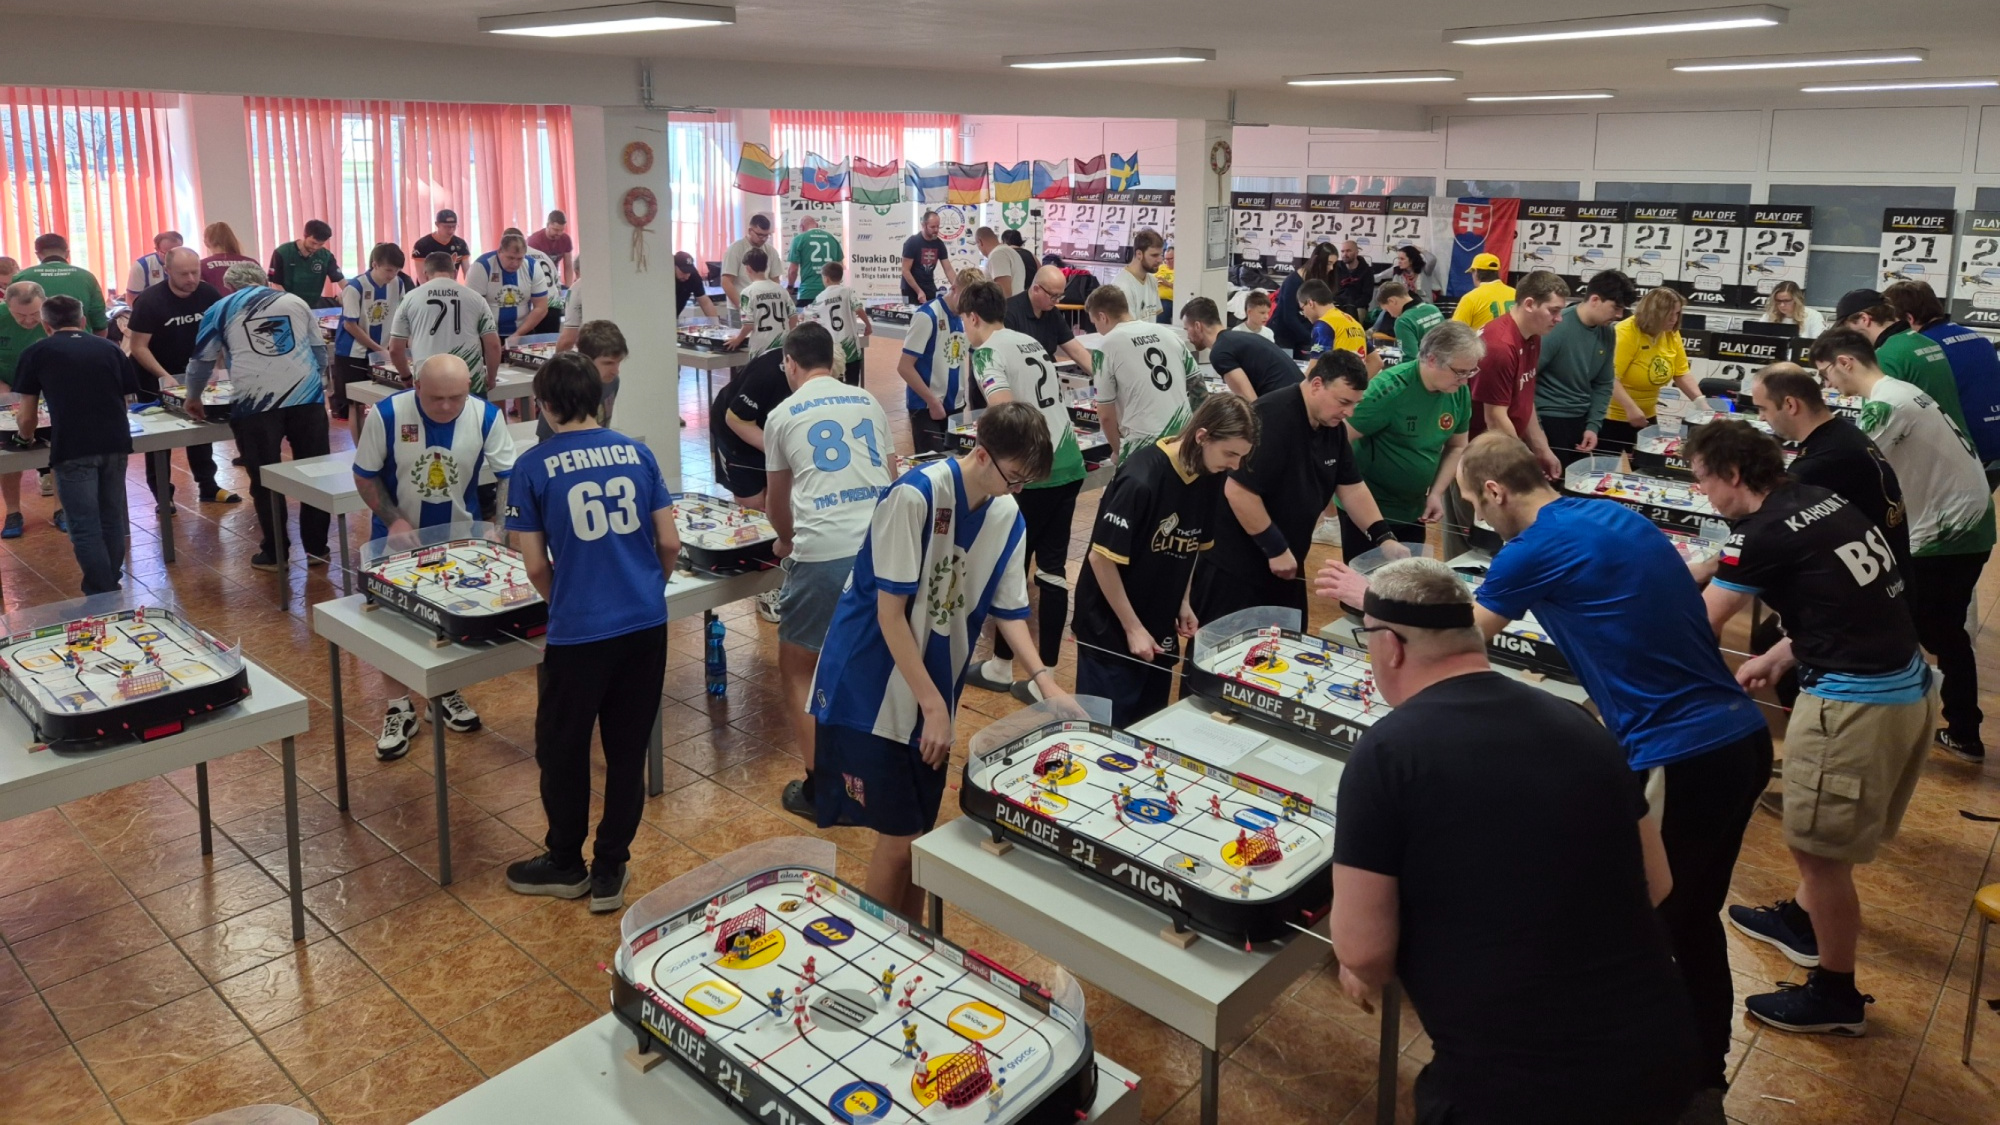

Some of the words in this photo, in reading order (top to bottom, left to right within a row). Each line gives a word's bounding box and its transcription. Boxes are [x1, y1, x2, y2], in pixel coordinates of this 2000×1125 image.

[791, 200, 835, 210] STIGA
[1047, 204, 1067, 222] 21
[1074, 205, 1096, 224] 21
[1367, 201, 1381, 209] OFF
[1412, 202, 1426, 210] OFF
[1528, 206, 1548, 214] PLAY
[1549, 206, 1566, 214] OFF
[1578, 207, 1599, 215] PLAY
[1600, 208, 1617, 216] OFF
[1635, 207, 1658, 216] PLAY
[1659, 208, 1678, 217] OFF
[1104, 206, 1127, 225] 21
[1136, 207, 1159, 226] 21
[1238, 211, 1263, 231] 21
[1274, 212, 1298, 232] 21
[1310, 214, 1337, 234] 21
[1692, 210, 1716, 219] PLAY
[1717, 211, 1736, 220] OFF
[1755, 211, 1781, 221] PLAY
[1782, 212, 1803, 222] OFF
[1892, 215, 1921, 225] PLAY
[1922, 216, 1945, 226] OFF
[1350, 216, 1377, 237] 21
[1392, 217, 1422, 238] 21
[1528, 222, 1561, 246] 21
[1578, 224, 1613, 248] 21
[1634, 225, 1673, 250] 21
[1692, 228, 1731, 253] 21
[1755, 230, 1796, 258] 21
[809, 241, 833, 262] 21
[852, 254, 888, 263] Slovakia
[889, 254, 903, 264] Op
[1100, 251, 1120, 259] STIGA
[1891, 235, 1938, 264] 21
[1971, 238, 2000, 267] 2
[1242, 261, 1262, 269] STIGA
[1273, 263, 1295, 271] STIGA
[1688, 291, 1725, 302] STIGA
[164, 312, 204, 327] STIGA
[426, 299, 461, 335] 71
[756, 301, 786, 333] 24
[829, 304, 844, 331] 6
[1964, 310, 2000, 322] STIG
[1131, 334, 1160, 347] KOCSIS
[1719, 341, 1749, 353] PLAY
[1751, 344, 1777, 355] OFF
[1143, 347, 1173, 391] 8
[1384, 357, 1398, 365] STIG
[739, 394, 758, 410] STIGA
[789, 396, 871, 416] MARTINEC
[1076, 410, 1089, 418] PLAY
[1832, 408, 1861, 418] STIG
[1407, 420, 1415, 432] 13
[807, 418, 882, 472] 81
[959, 437, 975, 446] PLAY
[544, 444, 641, 478] PERNICA
[567, 476, 641, 542] 63
[813, 494, 838, 510] THC
[1103, 512, 1129, 530] STIGA
[1651, 508, 1670, 521] 21
[1680, 514, 1730, 530] STIGA
[1784, 496, 1841, 532] KAHOUN
[367, 577, 382, 593] PLAY
[382, 584, 395, 599] OFF
[398, 593, 409, 610] 21
[413, 603, 441, 625] STIGA
[1492, 633, 1536, 657] TIGA
[1223, 682, 1256, 703] PLAY
[1256, 694, 1283, 712] OFF
[1292, 707, 1317, 731] 21
[1006, 742, 1023, 753] STIGA
[995, 802, 1029, 829] PLAY
[1032, 817, 1060, 843] OFF
[1071, 838, 1096, 868] 21
[1112, 862, 1182, 908] STIGA
[964, 959, 989, 979] Scandic
[641, 1000, 676, 1039] PLAY
[677, 1027, 706, 1061] OFF
[717, 1059, 744, 1103] 21
[1006, 1046, 1036, 1071] gyproc
